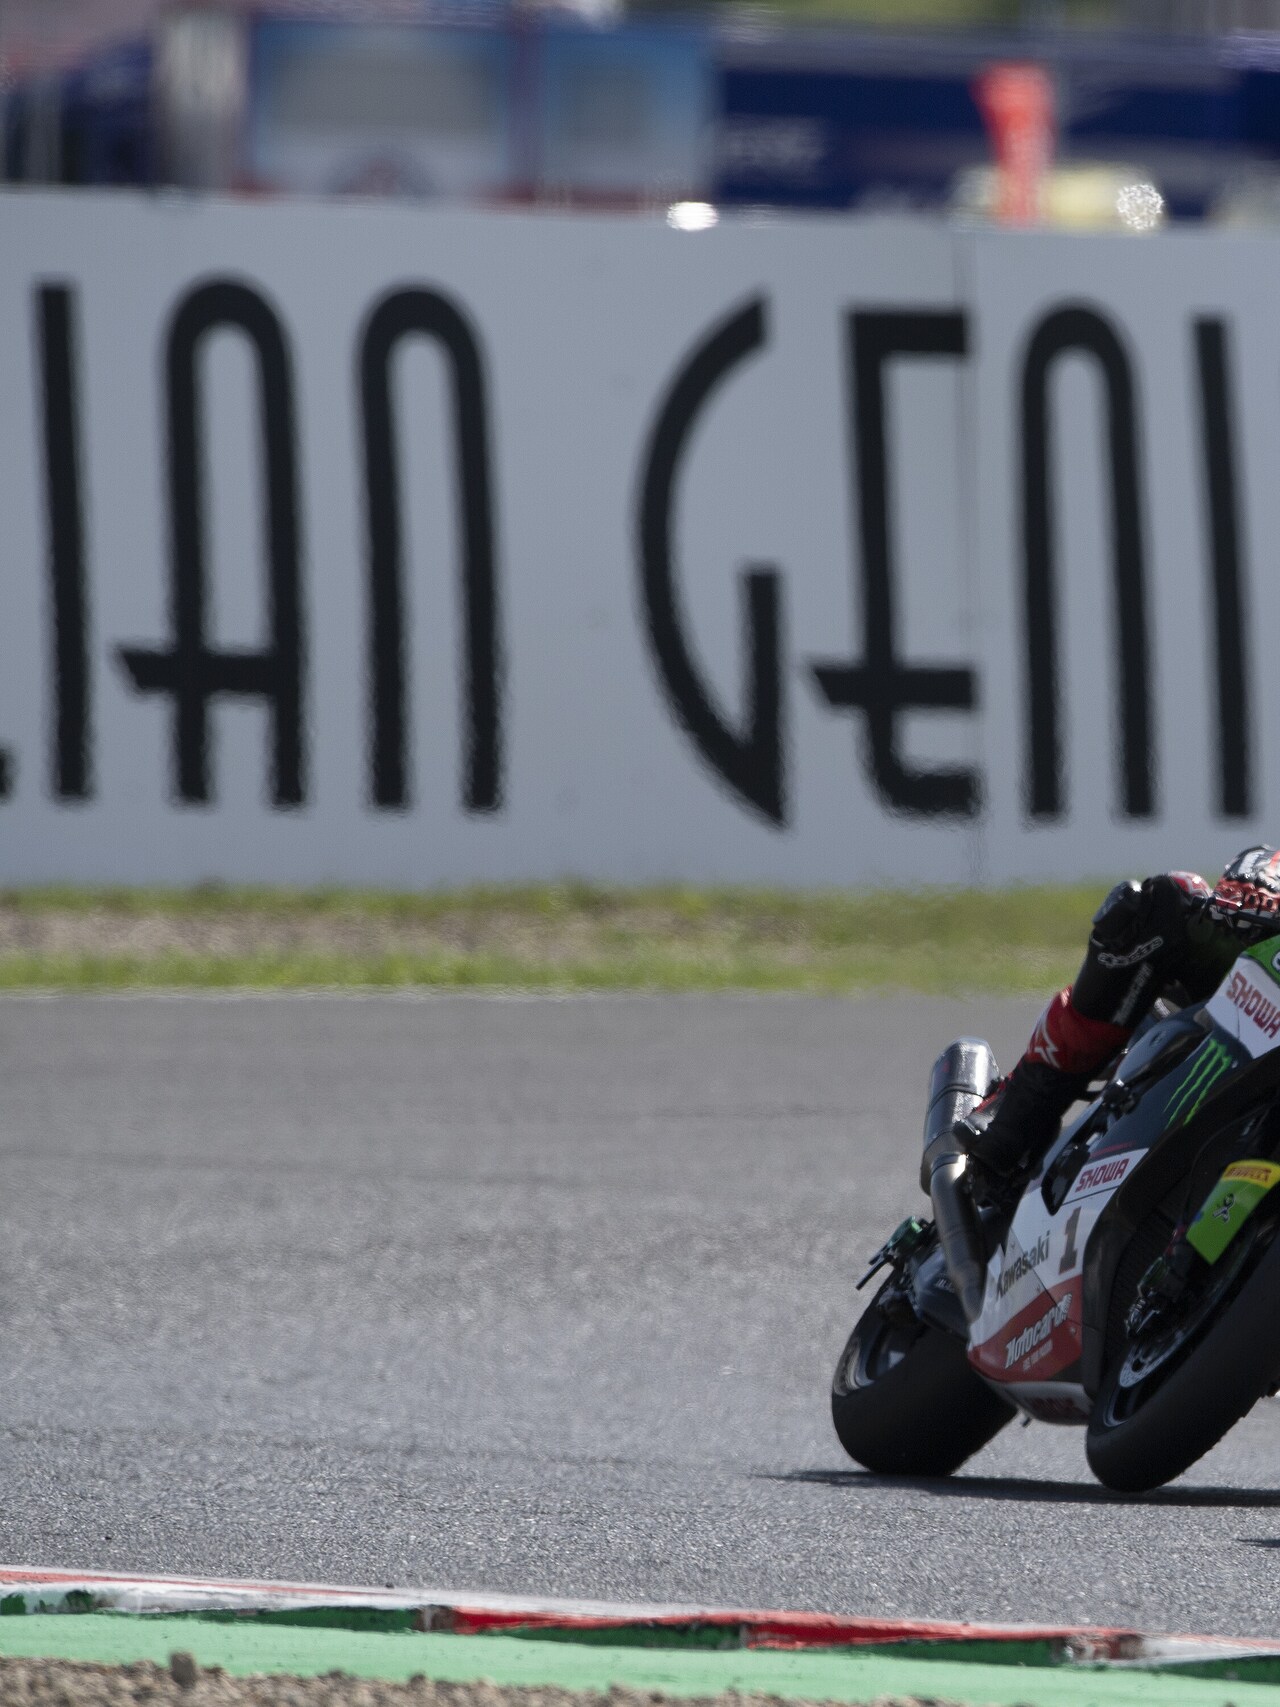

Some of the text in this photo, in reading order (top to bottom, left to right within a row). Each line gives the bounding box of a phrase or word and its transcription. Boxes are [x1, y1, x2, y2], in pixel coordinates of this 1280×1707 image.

[0, 282, 504, 808] IAN
[1074, 1158, 1130, 1193] SHOWA
[1058, 1206, 1082, 1276] 1
